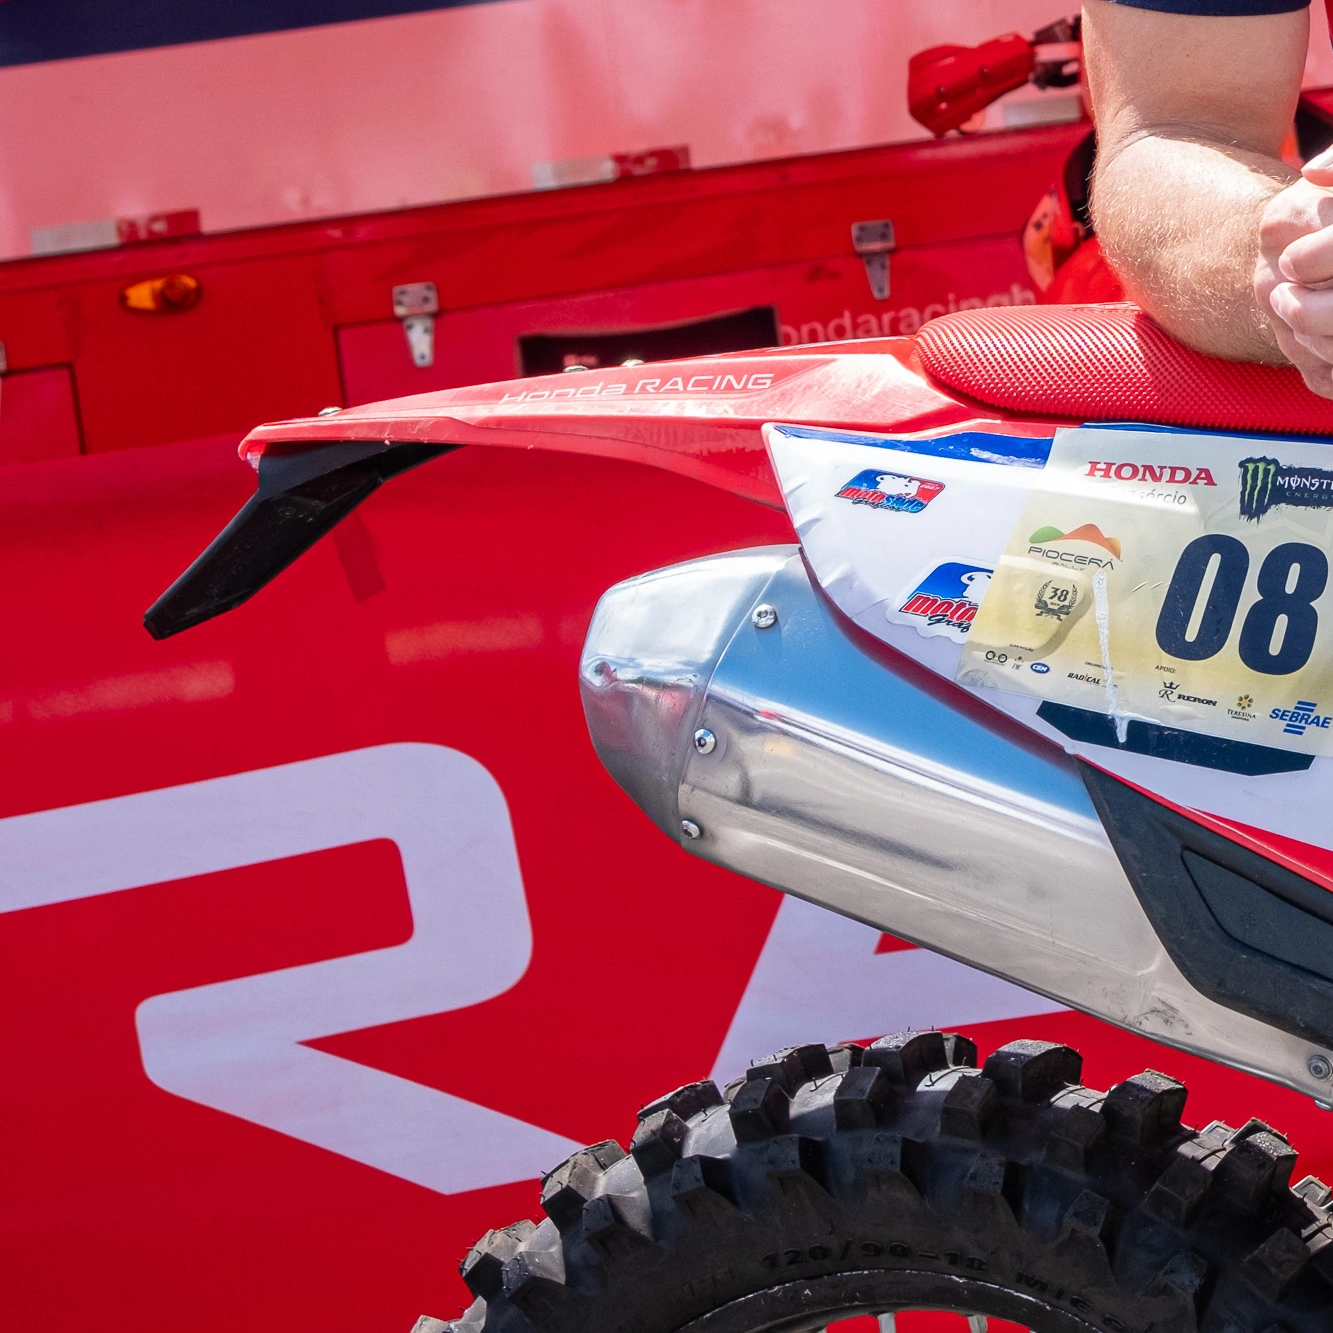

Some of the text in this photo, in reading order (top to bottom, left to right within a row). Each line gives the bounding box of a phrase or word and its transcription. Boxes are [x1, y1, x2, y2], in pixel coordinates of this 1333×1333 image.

[500, 373, 775, 404] Honda RACING
[1085, 461, 1217, 486] HONDA
[1028, 546, 1114, 570] PIOCERÁ
[1048, 586, 1069, 603] 38
[1155, 533, 1329, 676] 08
[1227, 708, 1256, 719] TERESINA
[1268, 707, 1333, 730] SEBRAE
